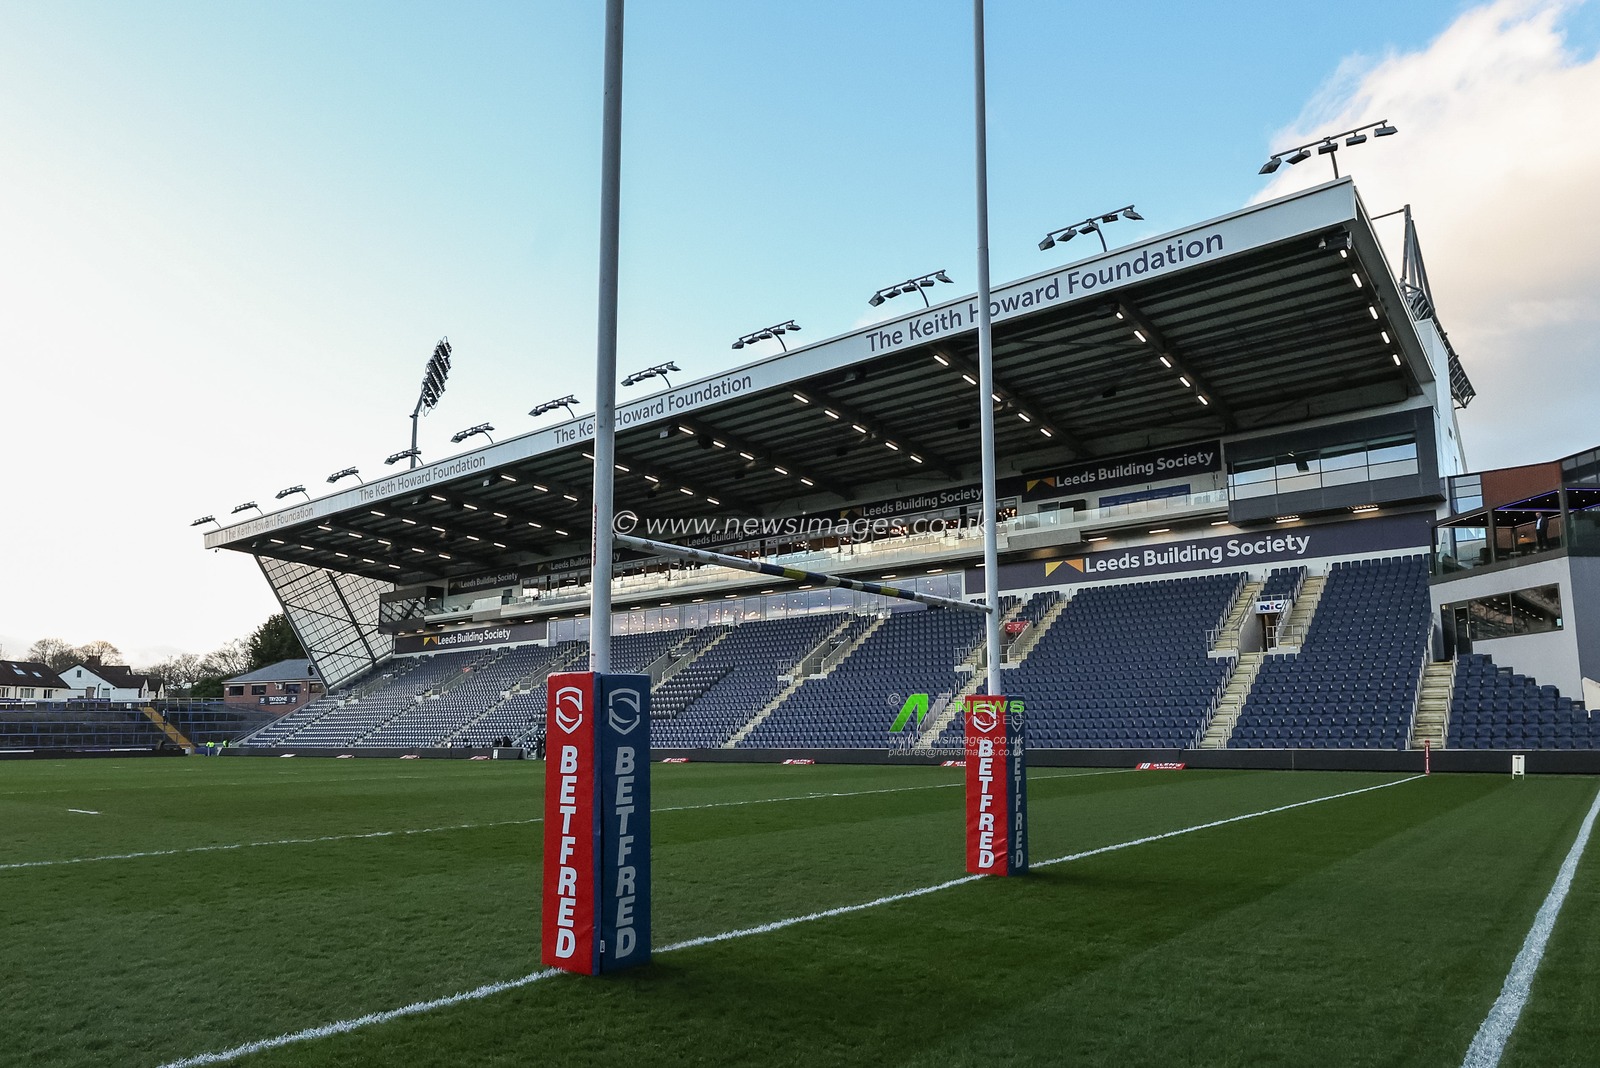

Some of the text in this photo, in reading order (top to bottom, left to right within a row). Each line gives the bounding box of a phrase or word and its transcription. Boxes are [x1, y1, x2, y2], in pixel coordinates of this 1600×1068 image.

[865, 233, 1224, 352] The Keith Howard Foundation
[554, 375, 752, 444] The Kei Howard Foundation
[359, 456, 486, 501] The Keith Howard Foundation
[1056, 451, 1214, 488] Leeds Building Society
[253, 516, 276, 532] Howard
[277, 507, 314, 525] Foundation
[863, 488, 983, 517] Leeds Building Society
[687, 535, 710, 547] Leeds
[711, 530, 743, 543] Building
[1085, 533, 1311, 574] Leeds Building Society
[551, 556, 591, 570] Leeds Buildin
[437, 628, 511, 645] Leeds Building Society
[978, 739, 995, 869] BETFRED
[1013, 741, 1024, 869] BETFRED
[555, 745, 578, 960] BETFRED
[615, 746, 637, 960] BETFRED
